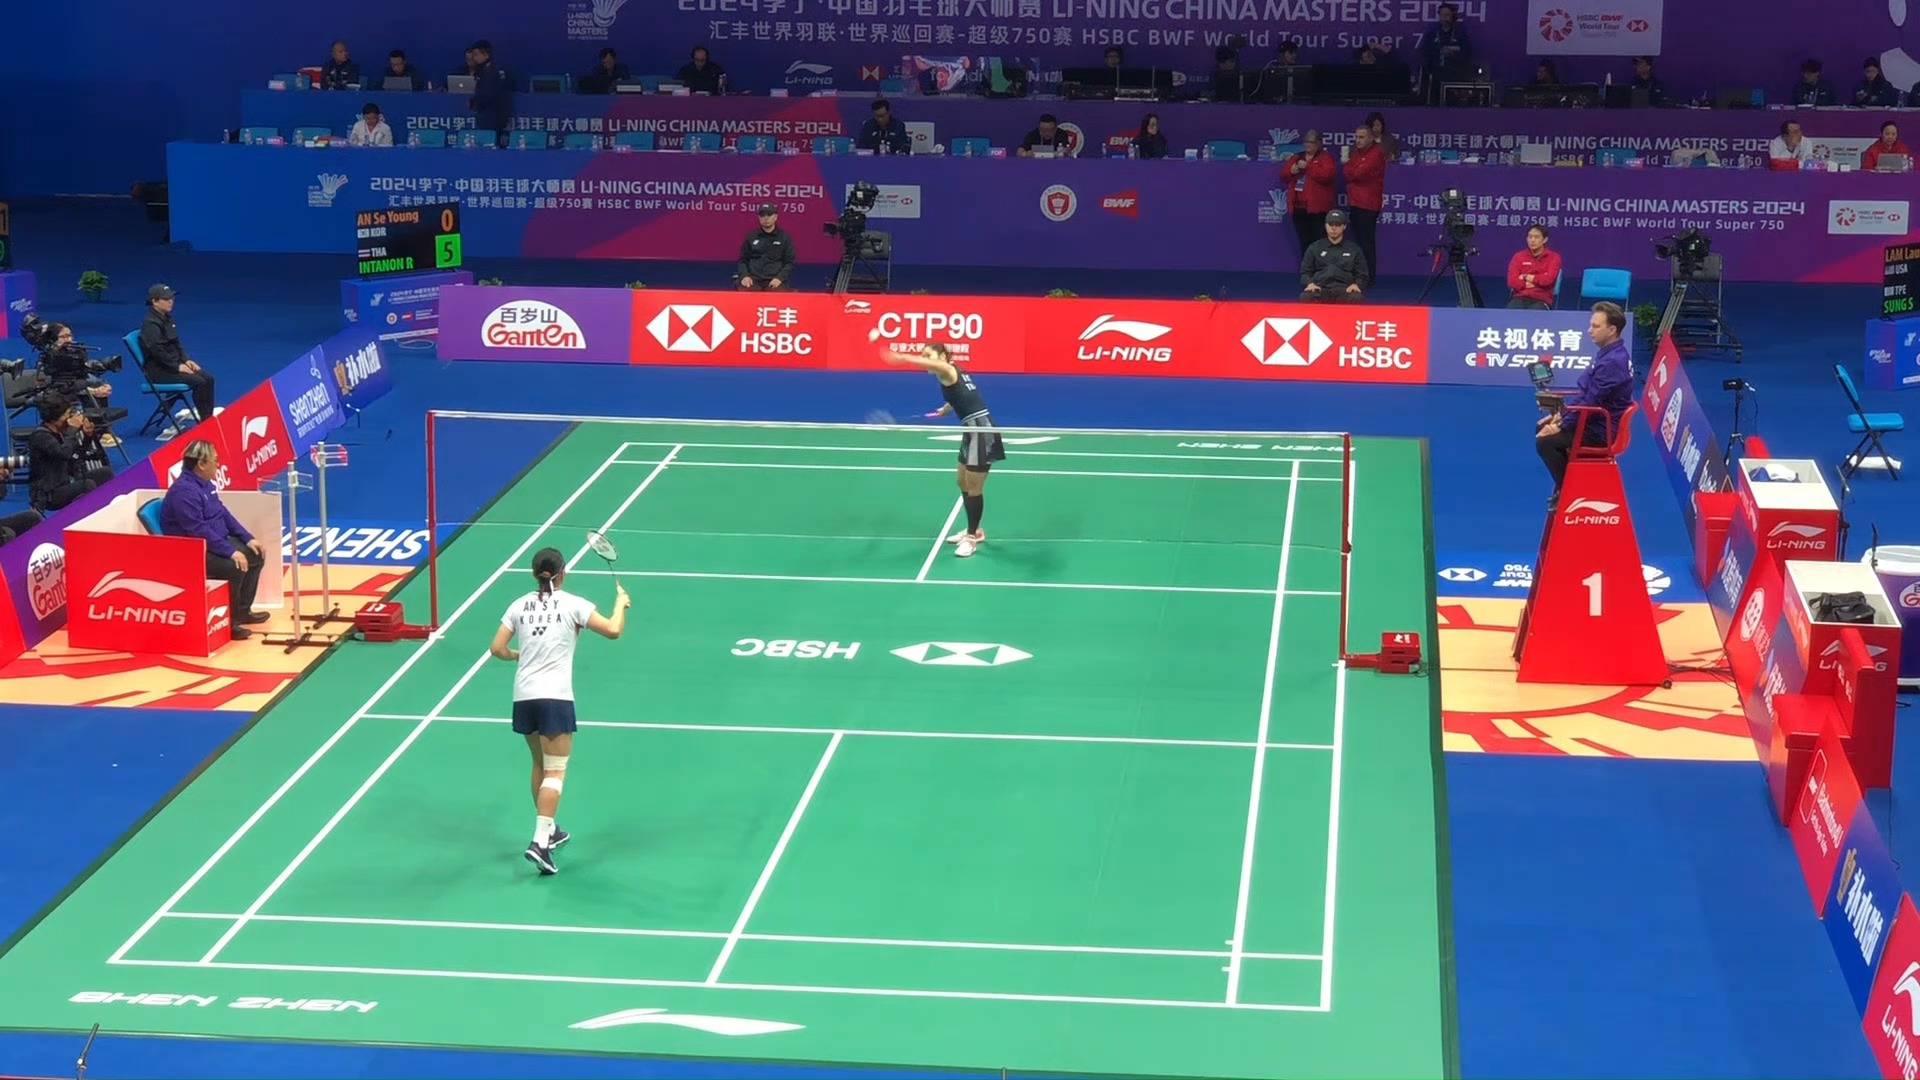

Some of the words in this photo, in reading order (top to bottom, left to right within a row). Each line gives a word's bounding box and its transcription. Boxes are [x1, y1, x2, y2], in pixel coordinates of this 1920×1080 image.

[1053, 0, 1160, 19] LI-NING
[1165, 0, 1260, 21] CHINA
[1262, 0, 1392, 22] MASTERS
[567, 27, 609, 36] MASTERS
[1083, 28, 1140, 46] HSBC
[1149, 29, 1195, 46] BWF
[784, 77, 833, 87] LI-NING
[609, 118, 667, 133] LI-NING
[669, 120, 720, 134] CHINA
[721, 121, 792, 135] MASTERS
[795, 122, 842, 135] 2024
[1599, 137, 1651, 150] CHINA
[1653, 137, 1728, 151] MASTERS
[1732, 139, 1769, 151] 202
[581, 179, 641, 194] LI-NING
[644, 180, 697, 196] CHINA
[698, 182, 771, 198] MASTERS
[775, 184, 824, 198] 2024
[598, 198, 631, 210] HSBC
[634, 199, 662, 210] BWF
[666, 200, 704, 212] World
[708, 201, 737, 212] Tour
[782, 203, 806, 214] 750
[1103, 198, 1136, 208] BWF
[1547, 197, 1612, 212] LI-NING
[1614, 198, 1669, 213] CHINA
[1671, 200, 1749, 214] MASTERS
[1752, 201, 1806, 215] 2024
[357, 213, 371, 226] AN
[373, 211, 387, 225] Se
[387, 210, 420, 225] Young
[440, 208, 454, 232] 0
[1563, 216, 1599, 228] HSBC
[1603, 217, 1632, 228] BWF
[1636, 217, 1676, 229] World
[1715, 219, 1755, 232] Super
[1760, 220, 1784, 231] 750
[370, 227, 387, 238] KOR
[371, 247, 387, 258] THA
[443, 241, 454, 264] 5
[359, 258, 404, 275] INTANON
[406, 256, 415, 270] R
[1884, 298, 1907, 313] SUNG
[1908, 296, 1914, 310] S
[500, 307, 558, 324] 百岁山
[756, 306, 798, 328] 汇丰
[877, 312, 983, 339] CTP90
[1354, 320, 1398, 342] 汇丰
[740, 332, 812, 354] HSBC
[1477, 327, 1583, 351] 央视体育
[1077, 345, 1173, 362] LI-NING
[1338, 345, 1412, 369] HSBC
[246, 438, 278, 474] LI-NING
[1564, 515, 1621, 525] LI-NING
[1766, 540, 1827, 551] LI-NING
[1581, 572, 1602, 617] 1
[87, 603, 187, 626] LI-NING
[523, 601, 537, 612] AN
[519, 613, 562, 625] KOREA
[731, 638, 861, 661] HSBC
[69, 991, 218, 1008] SHEN
[228, 997, 379, 1014] ZHEN
[1881, 1004, 1918, 1080] LI-NING
